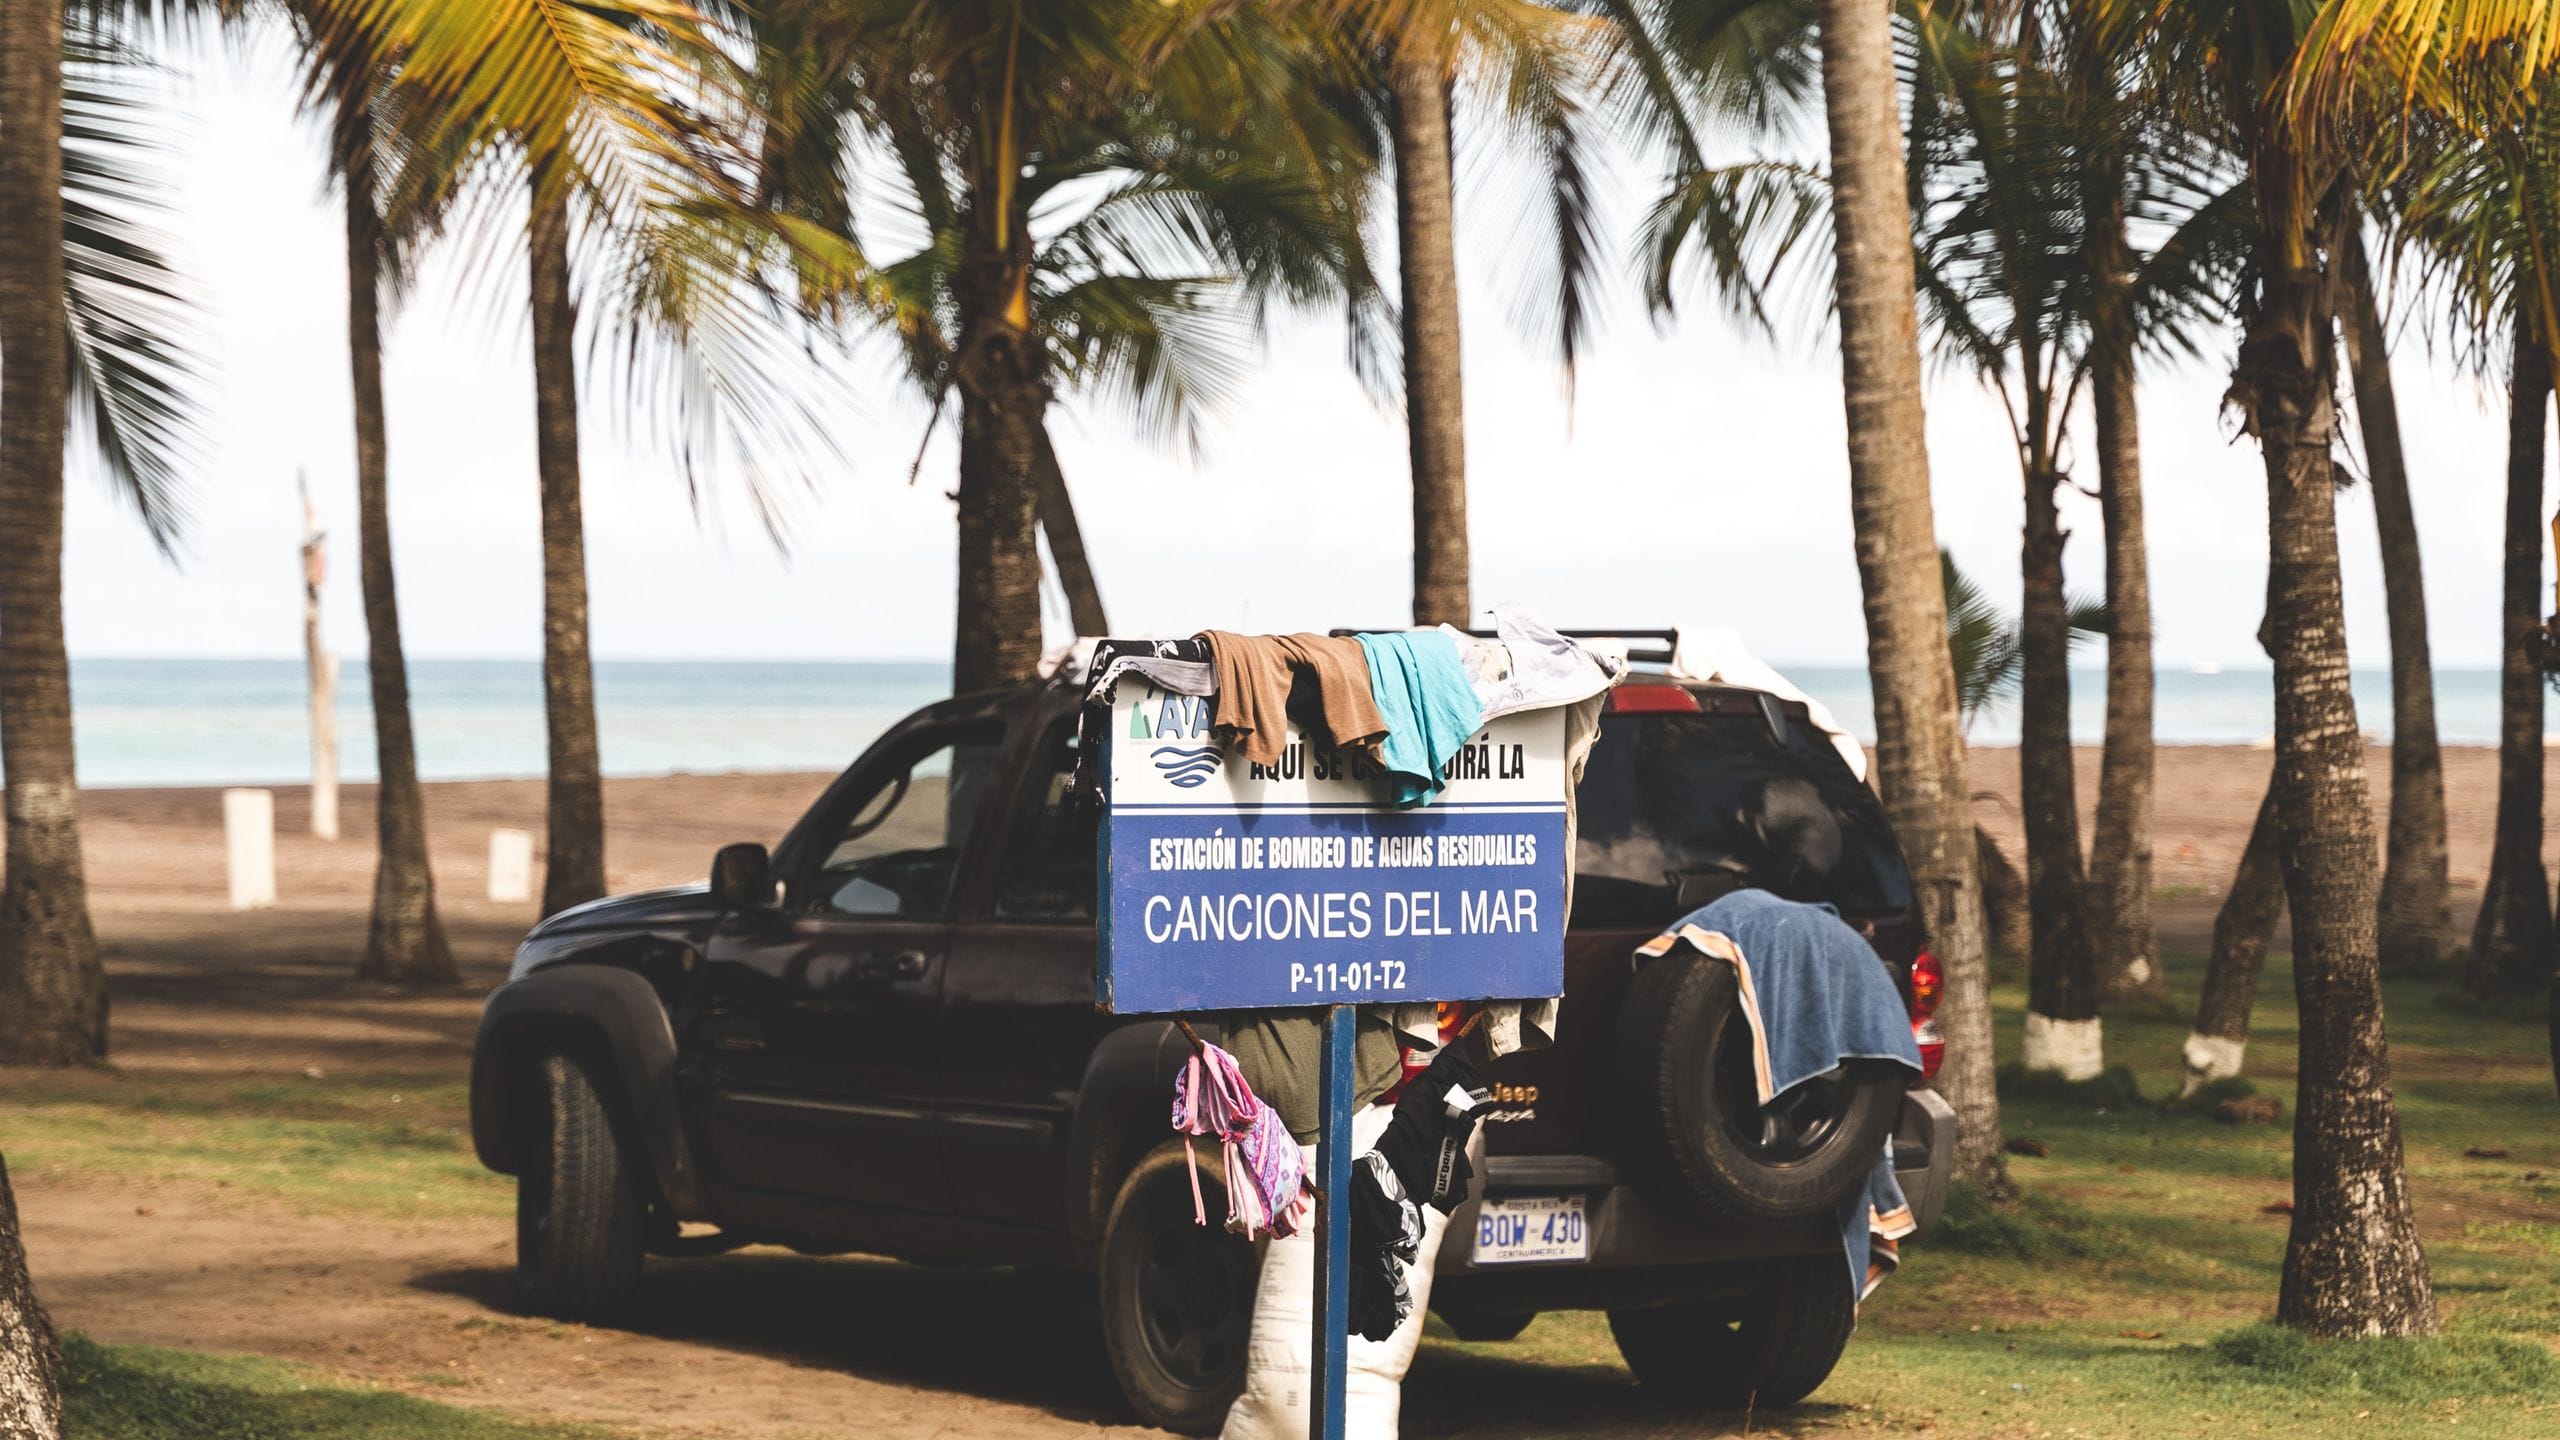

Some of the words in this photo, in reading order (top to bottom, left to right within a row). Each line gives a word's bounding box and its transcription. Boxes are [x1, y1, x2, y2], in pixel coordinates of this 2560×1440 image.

[1313, 743, 1343, 780] SE
[1499, 744, 1524, 779] LA
[1150, 827, 1236, 871] ESTACIÓN
[1241, 837, 1264, 870] DE
[1269, 836, 1346, 869] BOMBEO
[1351, 836, 1374, 868] DE
[1378, 835, 1434, 868] AGUAS
[1437, 834, 1537, 866] RESIDUALES
[1144, 891, 1372, 944] CANCIONES
[1384, 891, 1452, 937] DEL
[1461, 889, 1538, 935] MAR
[1290, 960, 1406, 993] P-11-01-T2
[1491, 1082, 1538, 1105] Jeep
